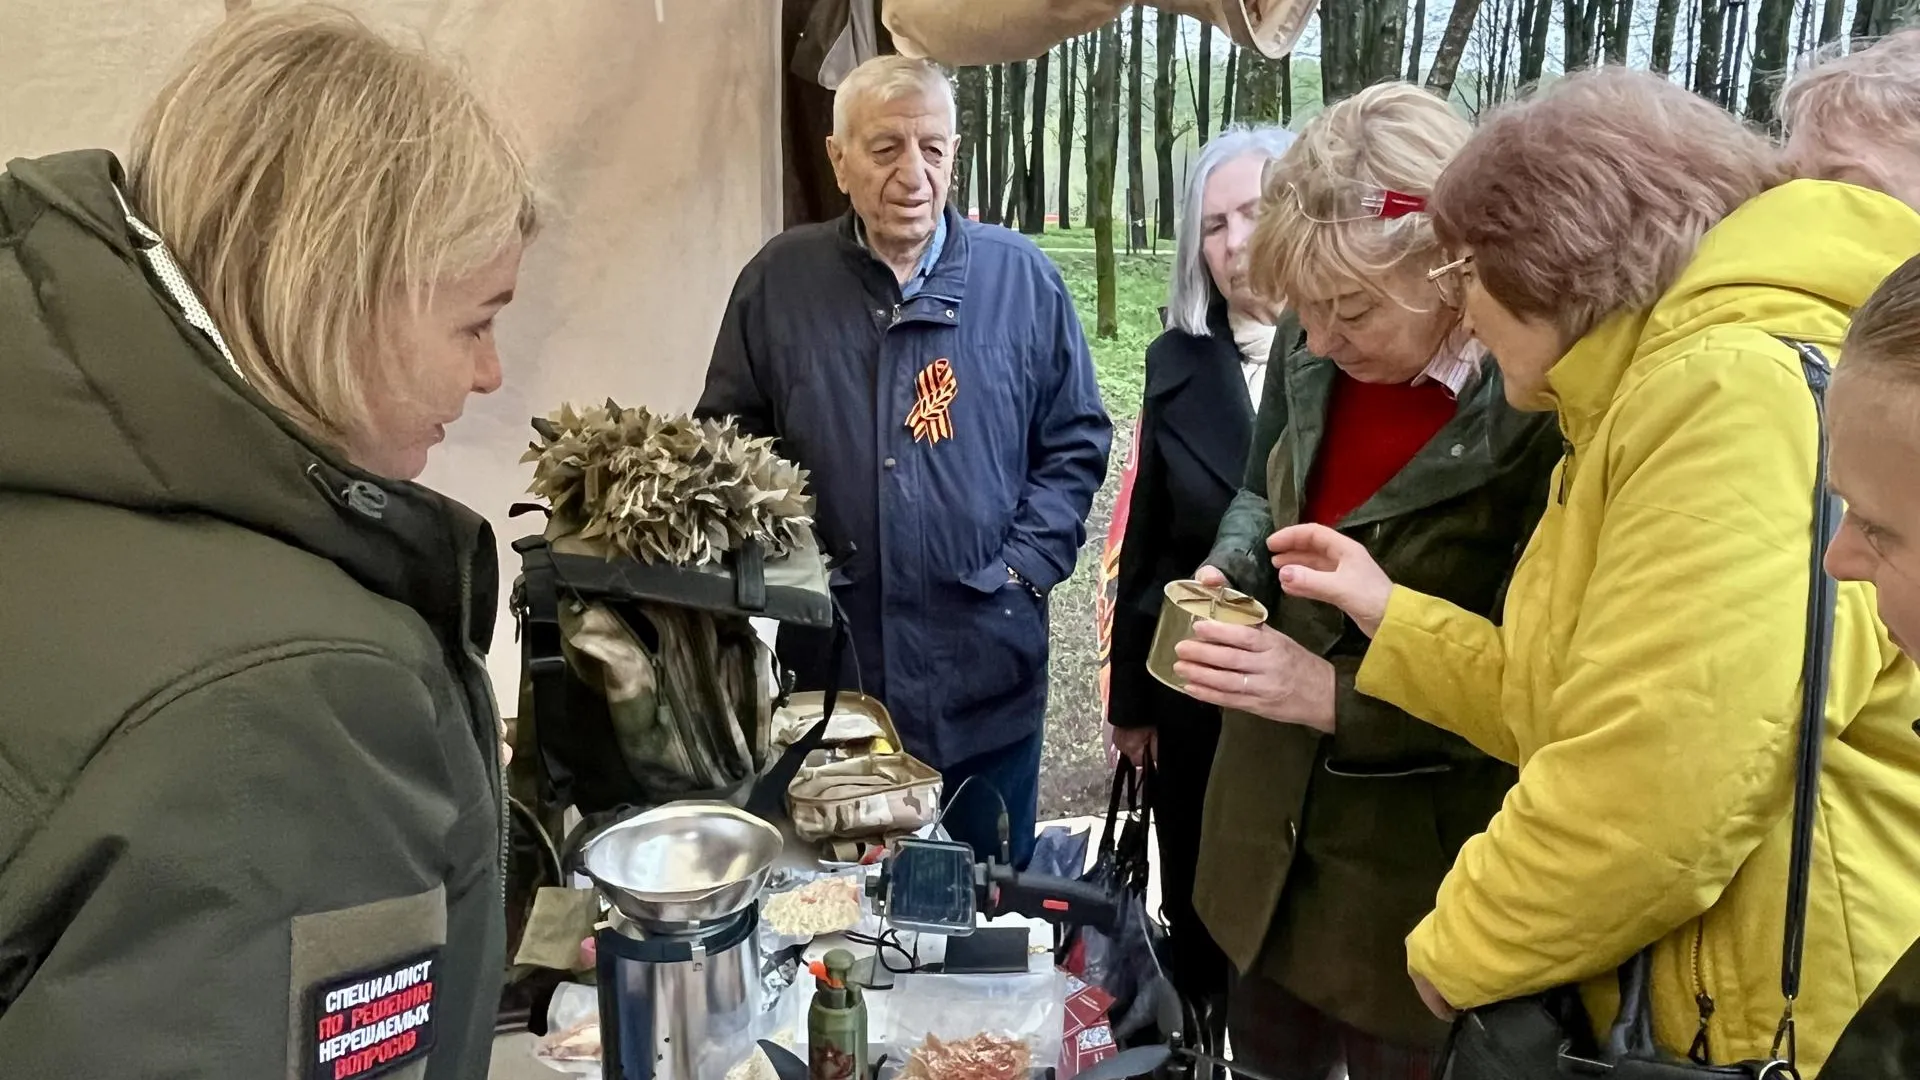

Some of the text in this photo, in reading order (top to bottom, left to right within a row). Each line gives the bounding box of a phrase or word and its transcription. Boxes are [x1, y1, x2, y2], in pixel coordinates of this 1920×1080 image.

[319, 982, 433, 1039] ПО РЕШЕНИЮ
[325, 960, 433, 1013] СПЕЦИАЛИСТ
[319, 1002, 431, 1063] НЕРЕШАЕМЫХ
[335, 1031, 416, 1080] ВОПРОСОВ
